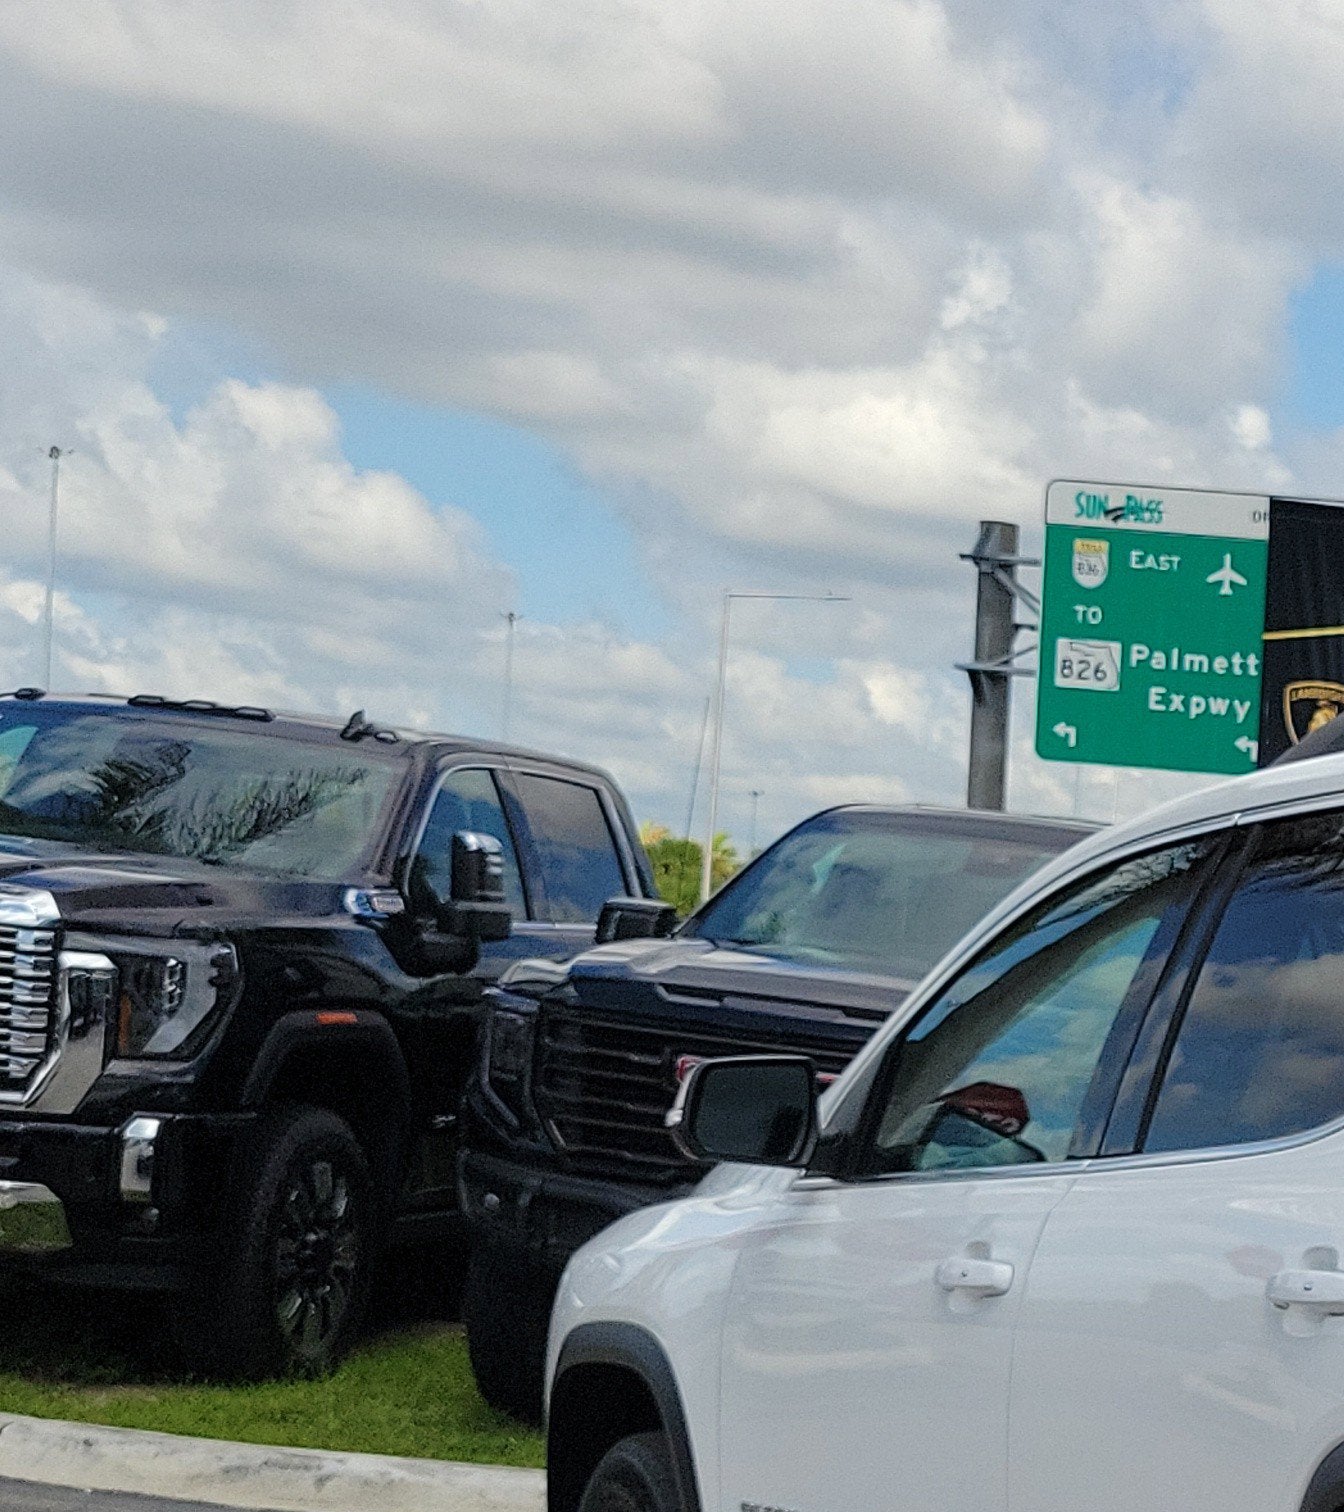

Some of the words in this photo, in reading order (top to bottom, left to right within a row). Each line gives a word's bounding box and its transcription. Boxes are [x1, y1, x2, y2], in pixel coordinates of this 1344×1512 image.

[1129, 549, 1181, 572] EAST
[1072, 604, 1103, 625] TO
[1060, 658, 1108, 682] 826
[1148, 685, 1251, 724] Expwy
